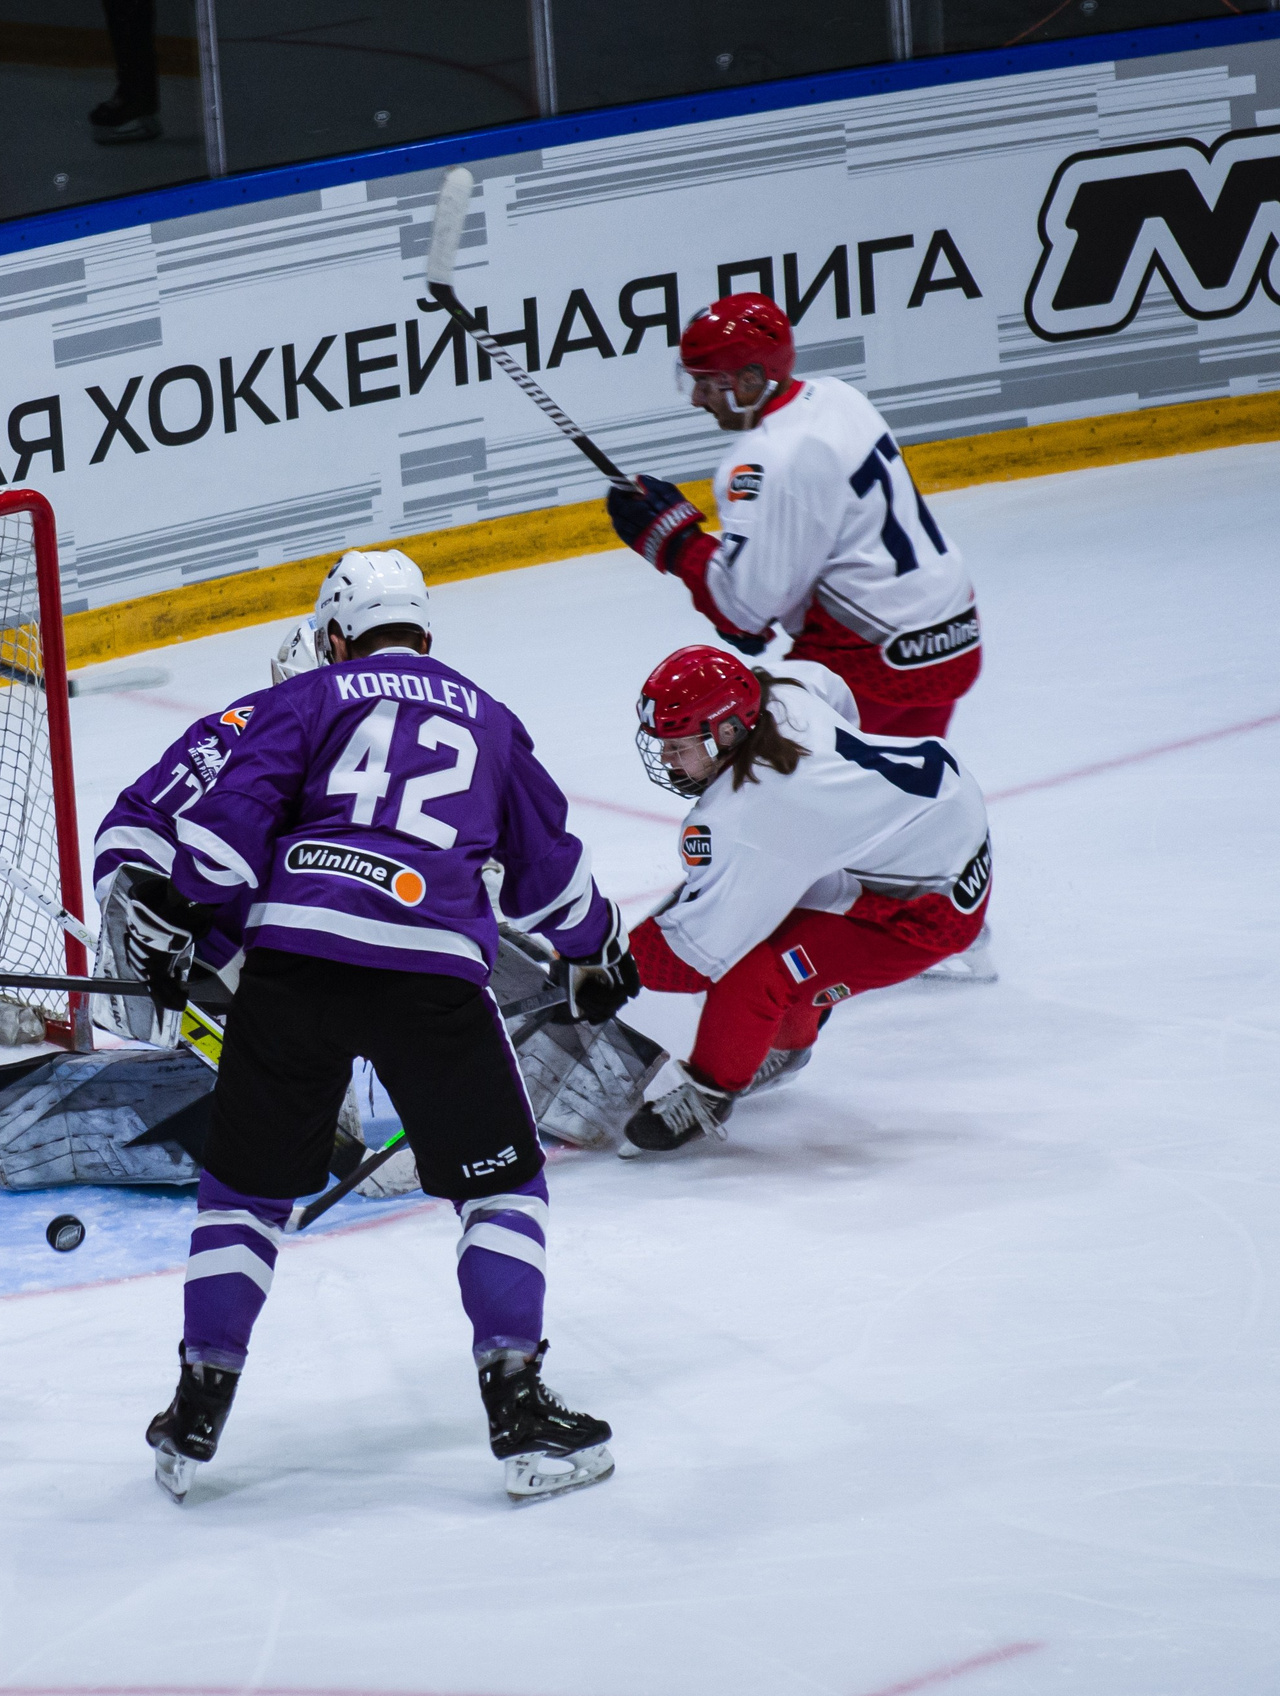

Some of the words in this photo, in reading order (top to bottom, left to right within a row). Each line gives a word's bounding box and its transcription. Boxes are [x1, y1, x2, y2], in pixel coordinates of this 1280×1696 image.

[84, 272, 679, 465] ХОККЕЙНАЯ
[335, 672, 478, 719] KOROLEV
[326, 698, 479, 851] 42
[298, 848, 388, 882] Winline
[686, 840, 710, 853] Win
